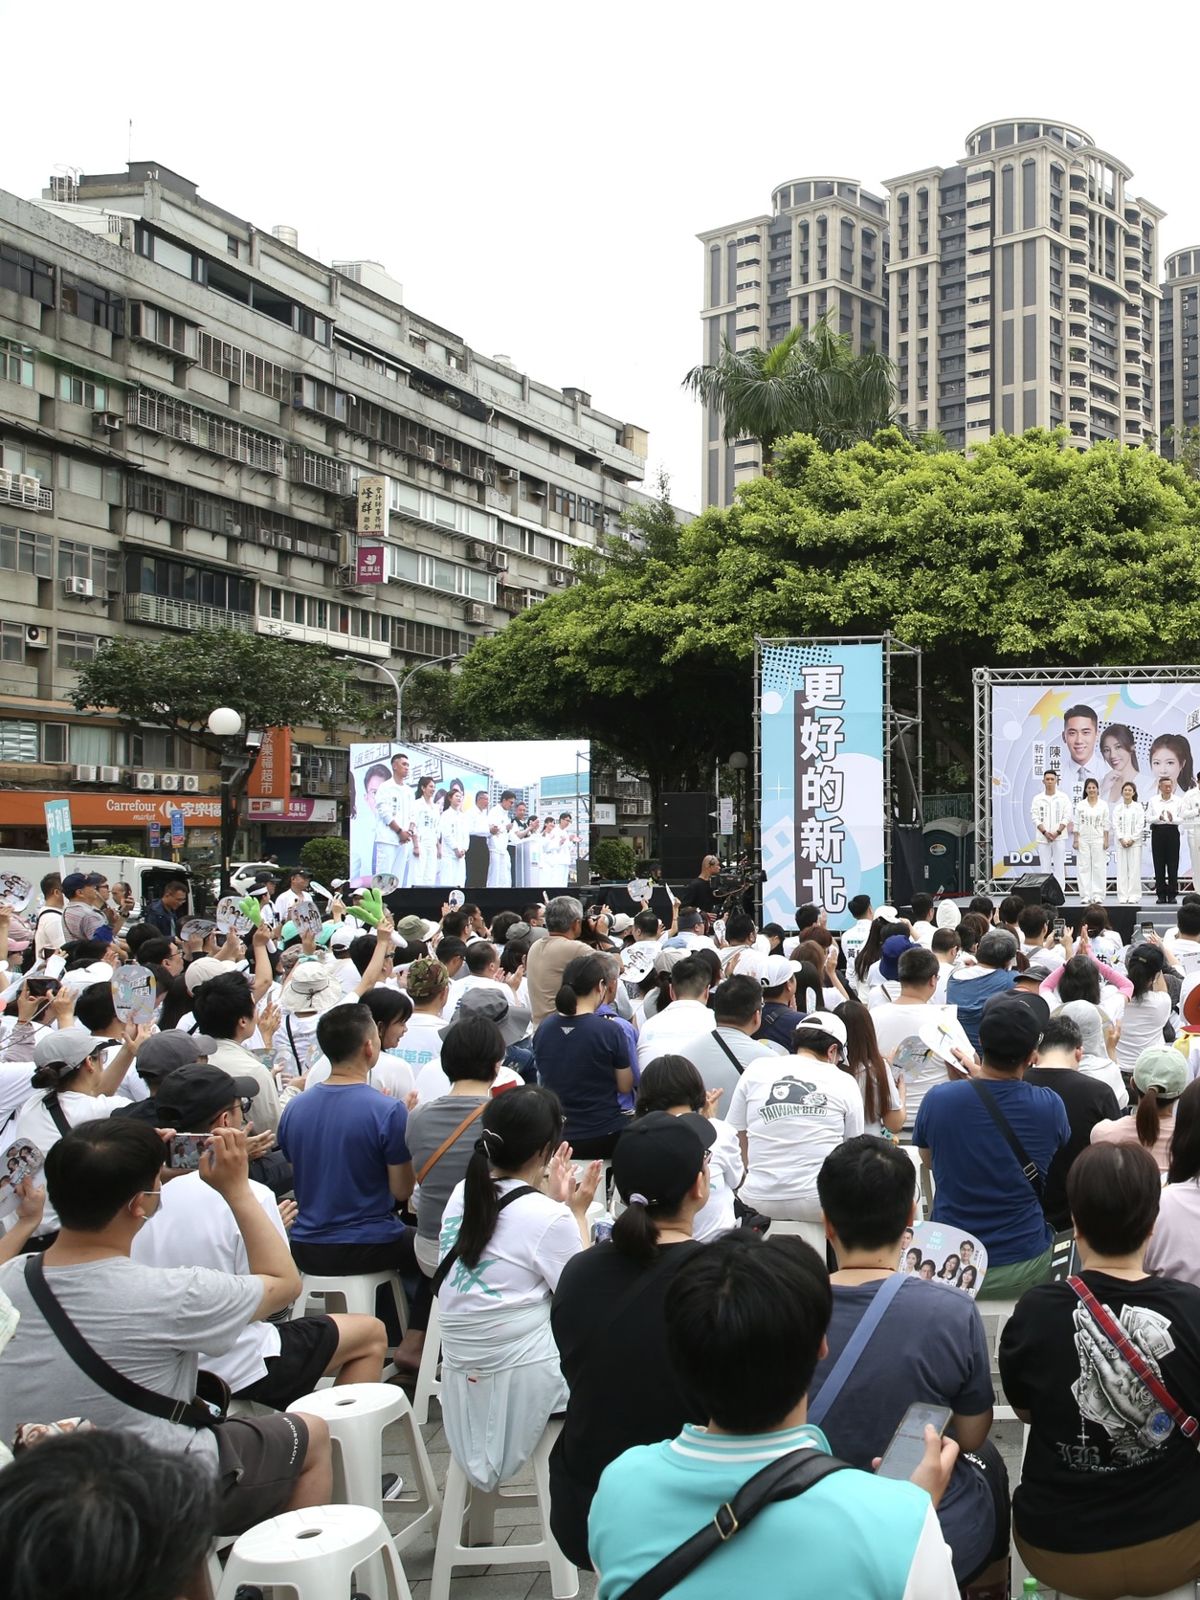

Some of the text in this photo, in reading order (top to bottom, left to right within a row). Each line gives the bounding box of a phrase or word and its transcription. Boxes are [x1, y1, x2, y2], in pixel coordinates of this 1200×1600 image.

[801, 665, 845, 914] 更好的新北
[106, 799, 156, 811] Carrefour
[1009, 851, 1033, 864] DO
[760, 1104, 825, 1122] TAIWAN BEER
